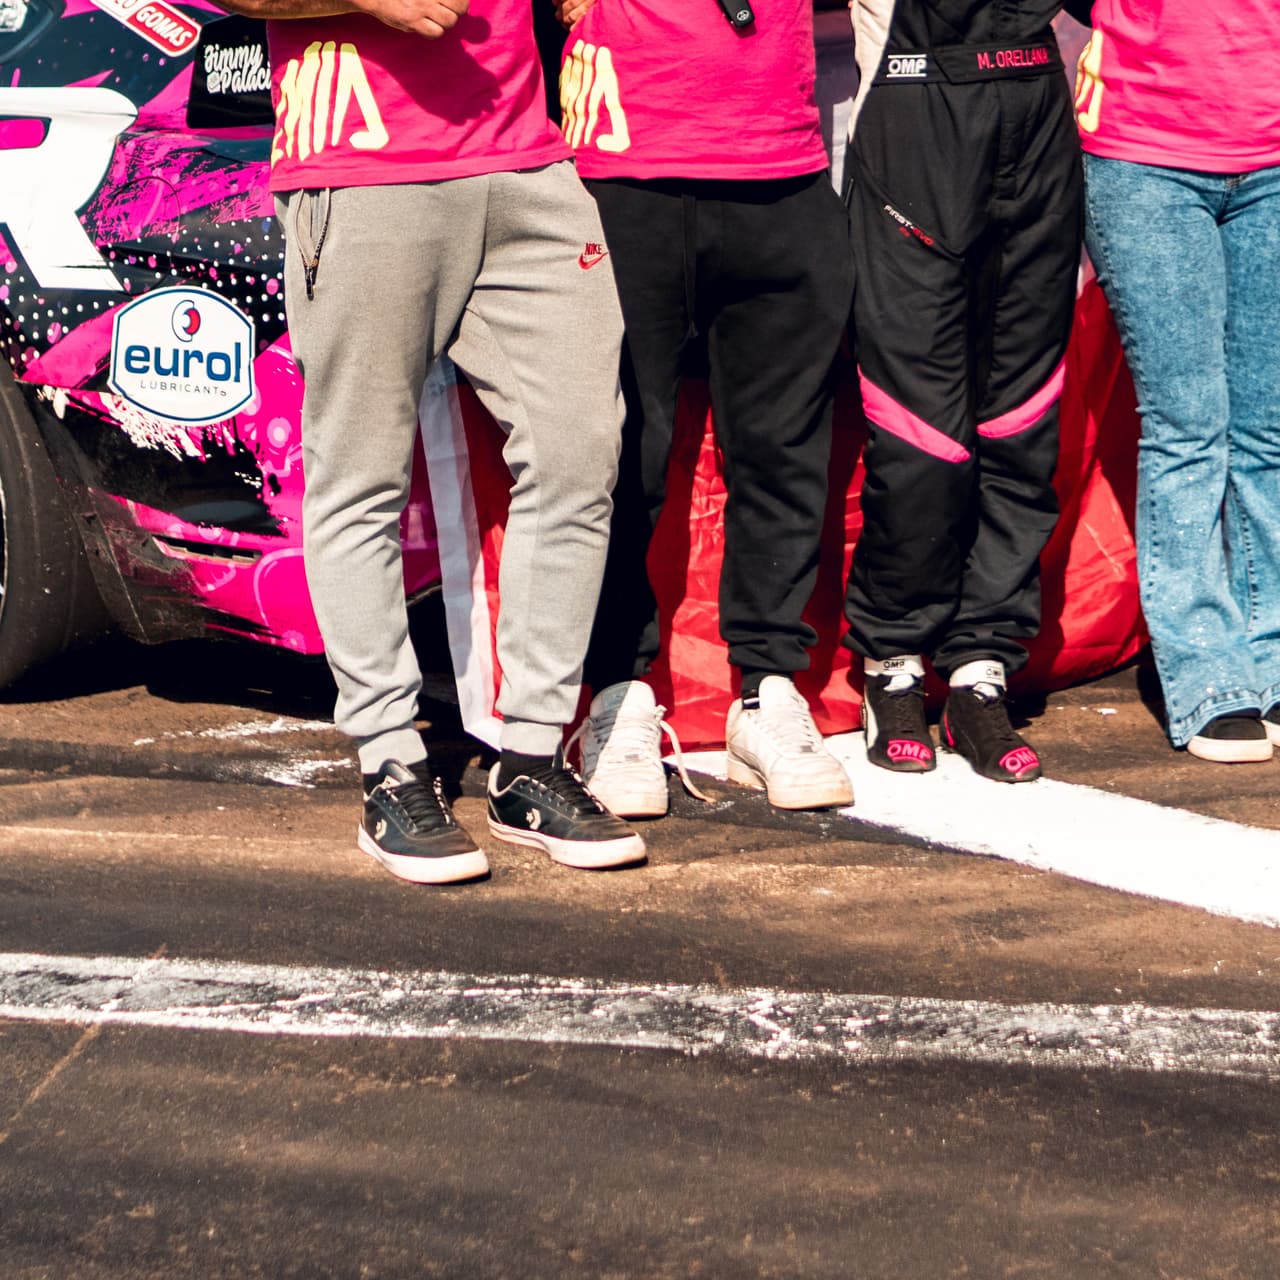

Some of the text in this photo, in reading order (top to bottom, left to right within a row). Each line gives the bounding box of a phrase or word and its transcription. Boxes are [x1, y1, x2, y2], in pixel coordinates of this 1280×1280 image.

[136, 5, 194, 48] GOMAS
[204, 42, 264, 74] Jimmy
[888, 57, 927, 75] OMP
[977, 47, 1050, 70] M. ORELLANA
[585, 242, 603, 255] NIKE
[124, 341, 242, 384] eurol
[139, 380, 228, 398] LUBRICANTS
[883, 660, 906, 670] OMP
[886, 742, 933, 762] OMP
